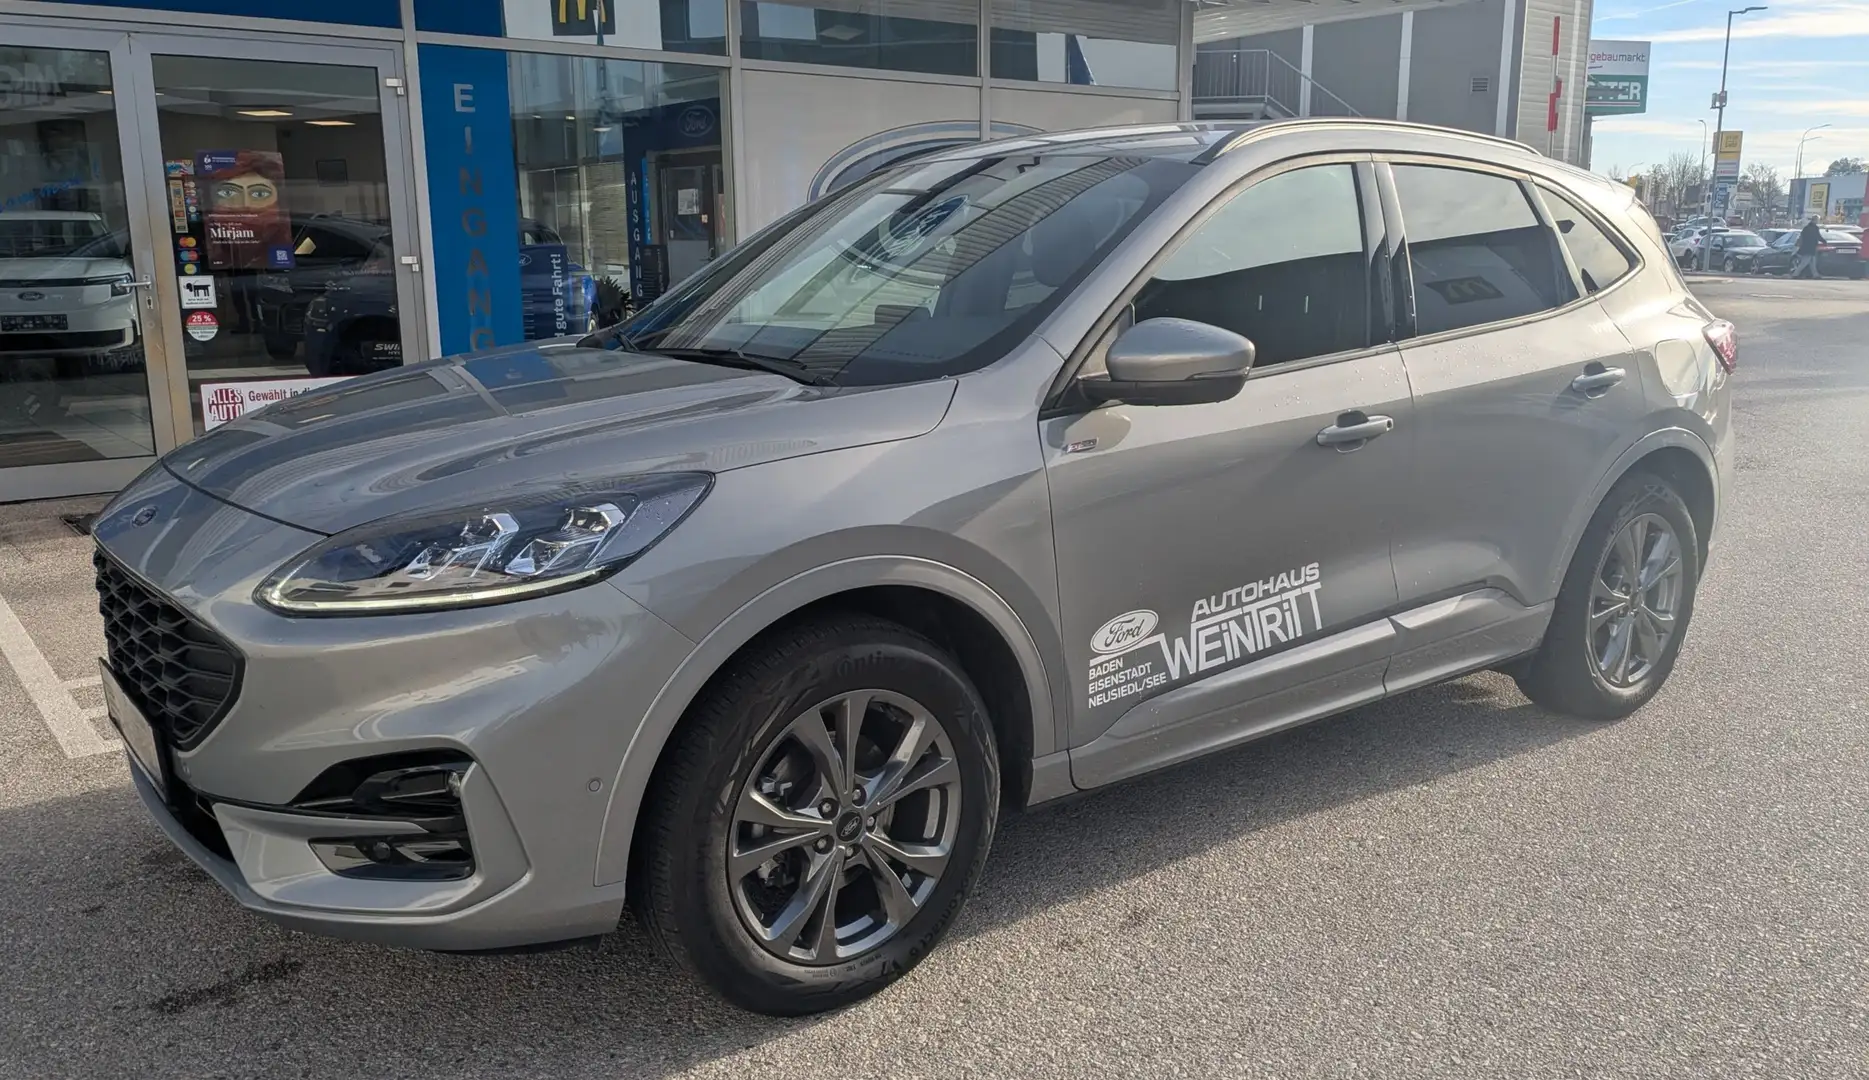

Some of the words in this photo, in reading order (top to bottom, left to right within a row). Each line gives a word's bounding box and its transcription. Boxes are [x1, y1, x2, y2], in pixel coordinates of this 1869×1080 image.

[1589, 52, 1646, 63] gebaumarkt
[452, 83, 496, 352] EINGANG
[210, 227, 255, 240] Mirjam
[630, 172, 644, 297] AUSGANG
[550, 252, 565, 296] Fahrt!
[191, 314, 202, 323] 25
[554, 297, 568, 330] gute
[374, 343, 400, 351] SWI
[207, 388, 243, 404] ALLES
[248, 389, 287, 401] Gewählt
[208, 403, 244, 421] AUTO
[1190, 561, 1320, 623] AUTOHAUS
[1104, 619, 1144, 648] Ford
[1088, 657, 1124, 681] BADEN
[1088, 662, 1152, 695] EISENSTADT
[1088, 672, 1167, 709] NEUSIEDL/SEE
